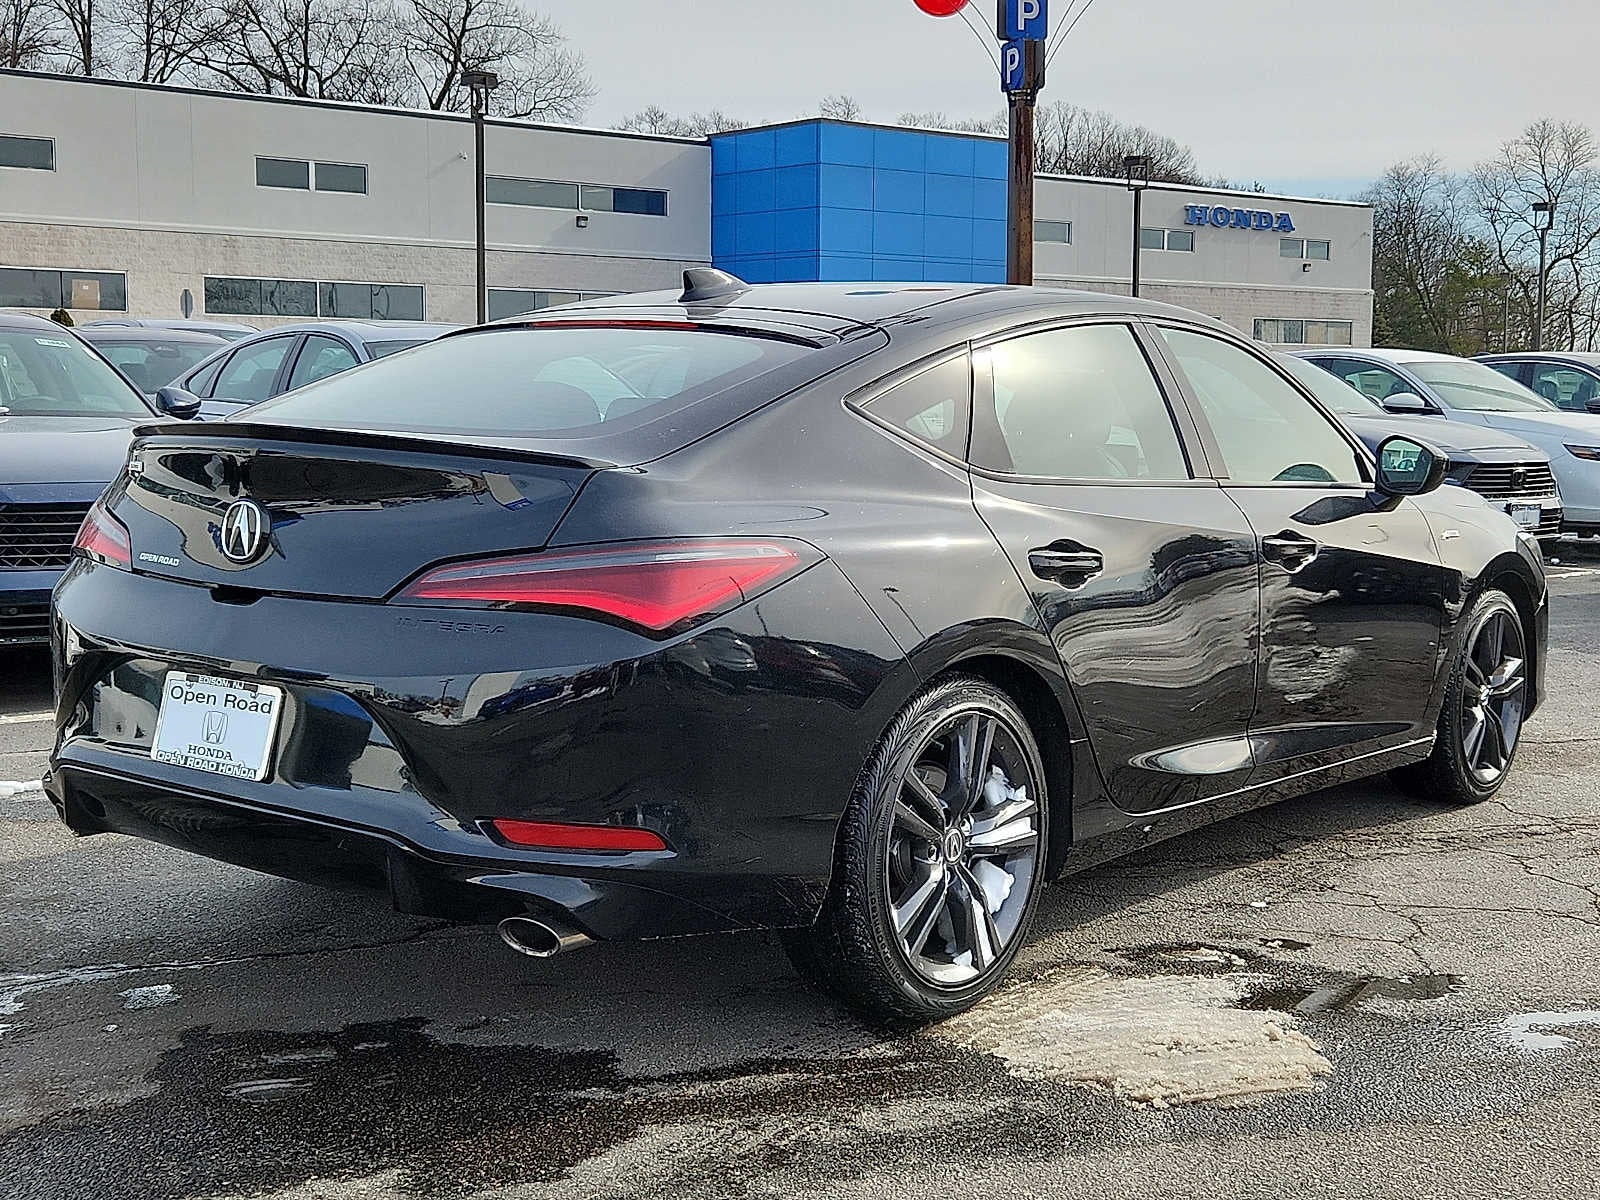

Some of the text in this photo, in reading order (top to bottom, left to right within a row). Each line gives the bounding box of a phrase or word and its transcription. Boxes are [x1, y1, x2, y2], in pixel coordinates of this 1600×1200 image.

[1017, 0, 1040, 30] P
[1006, 47, 1020, 83] P
[1184, 203, 1296, 232] HONDA
[139, 552, 180, 567] OPEN ROAD
[170, 685, 273, 715] Open Road
[156, 750, 256, 779] OPEN ROAD HONDA
[187, 744, 234, 761] HONDA
